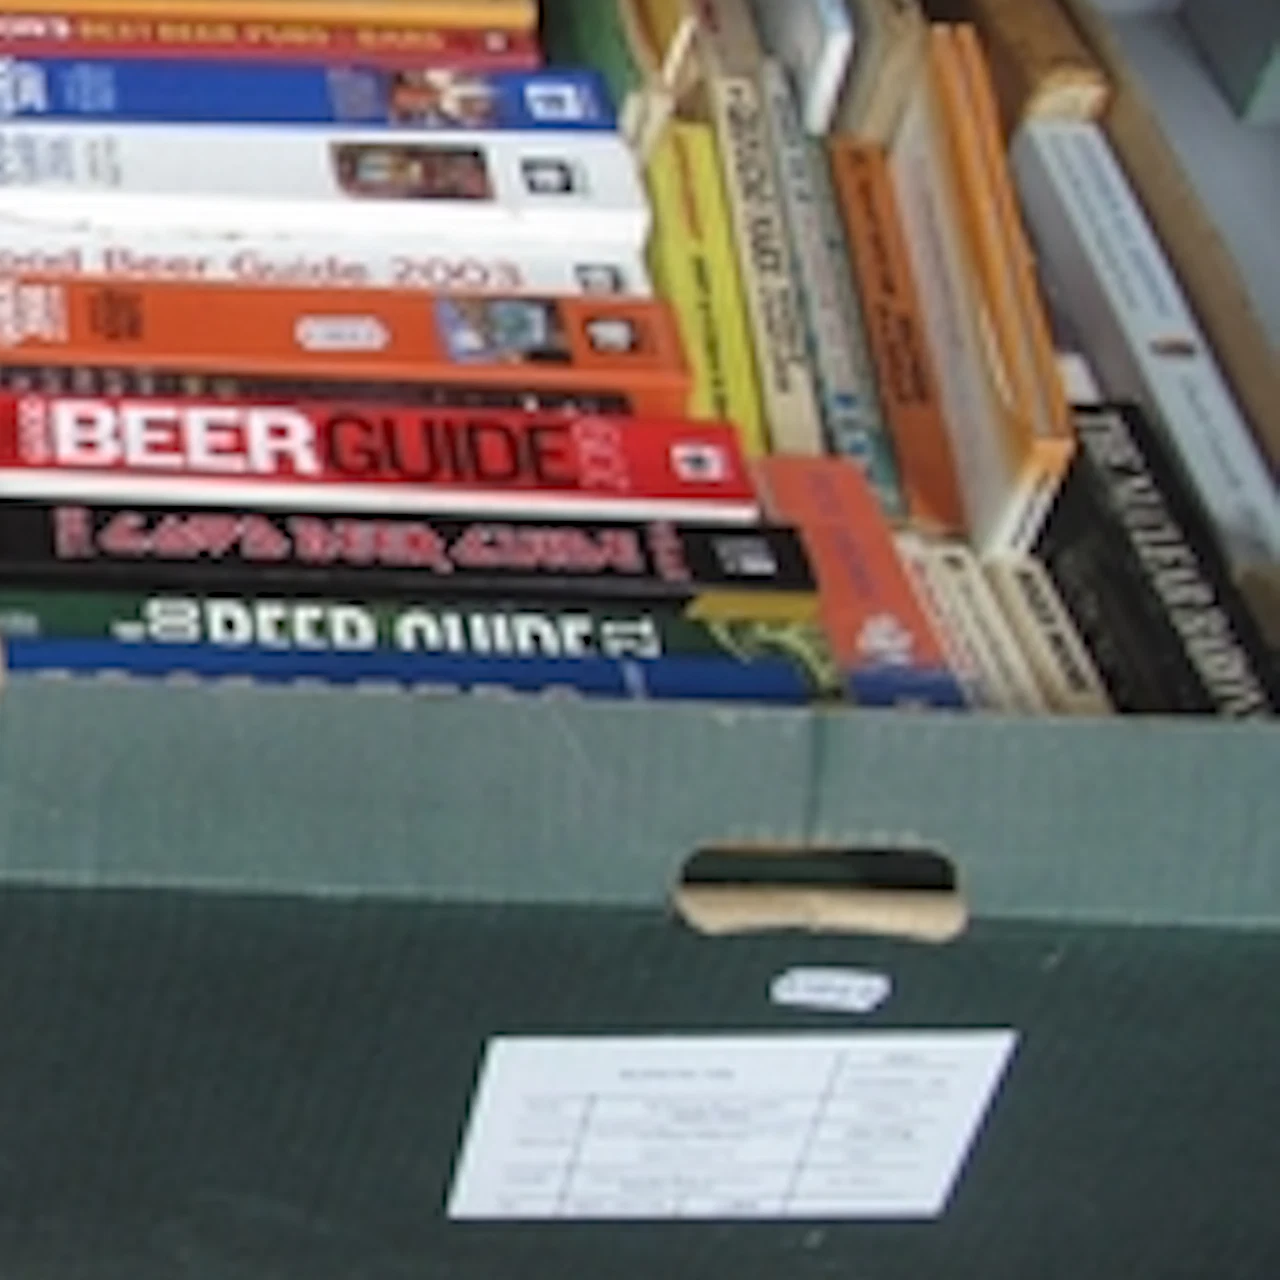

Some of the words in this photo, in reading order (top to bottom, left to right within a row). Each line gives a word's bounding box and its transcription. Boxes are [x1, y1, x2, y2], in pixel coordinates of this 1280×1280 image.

[103, 244, 210, 279] Beer
[229, 247, 368, 284] Guide
[393, 255, 524, 288] 2003
[51, 399, 320, 476] BEER
[325, 411, 578, 485] GUIDE
